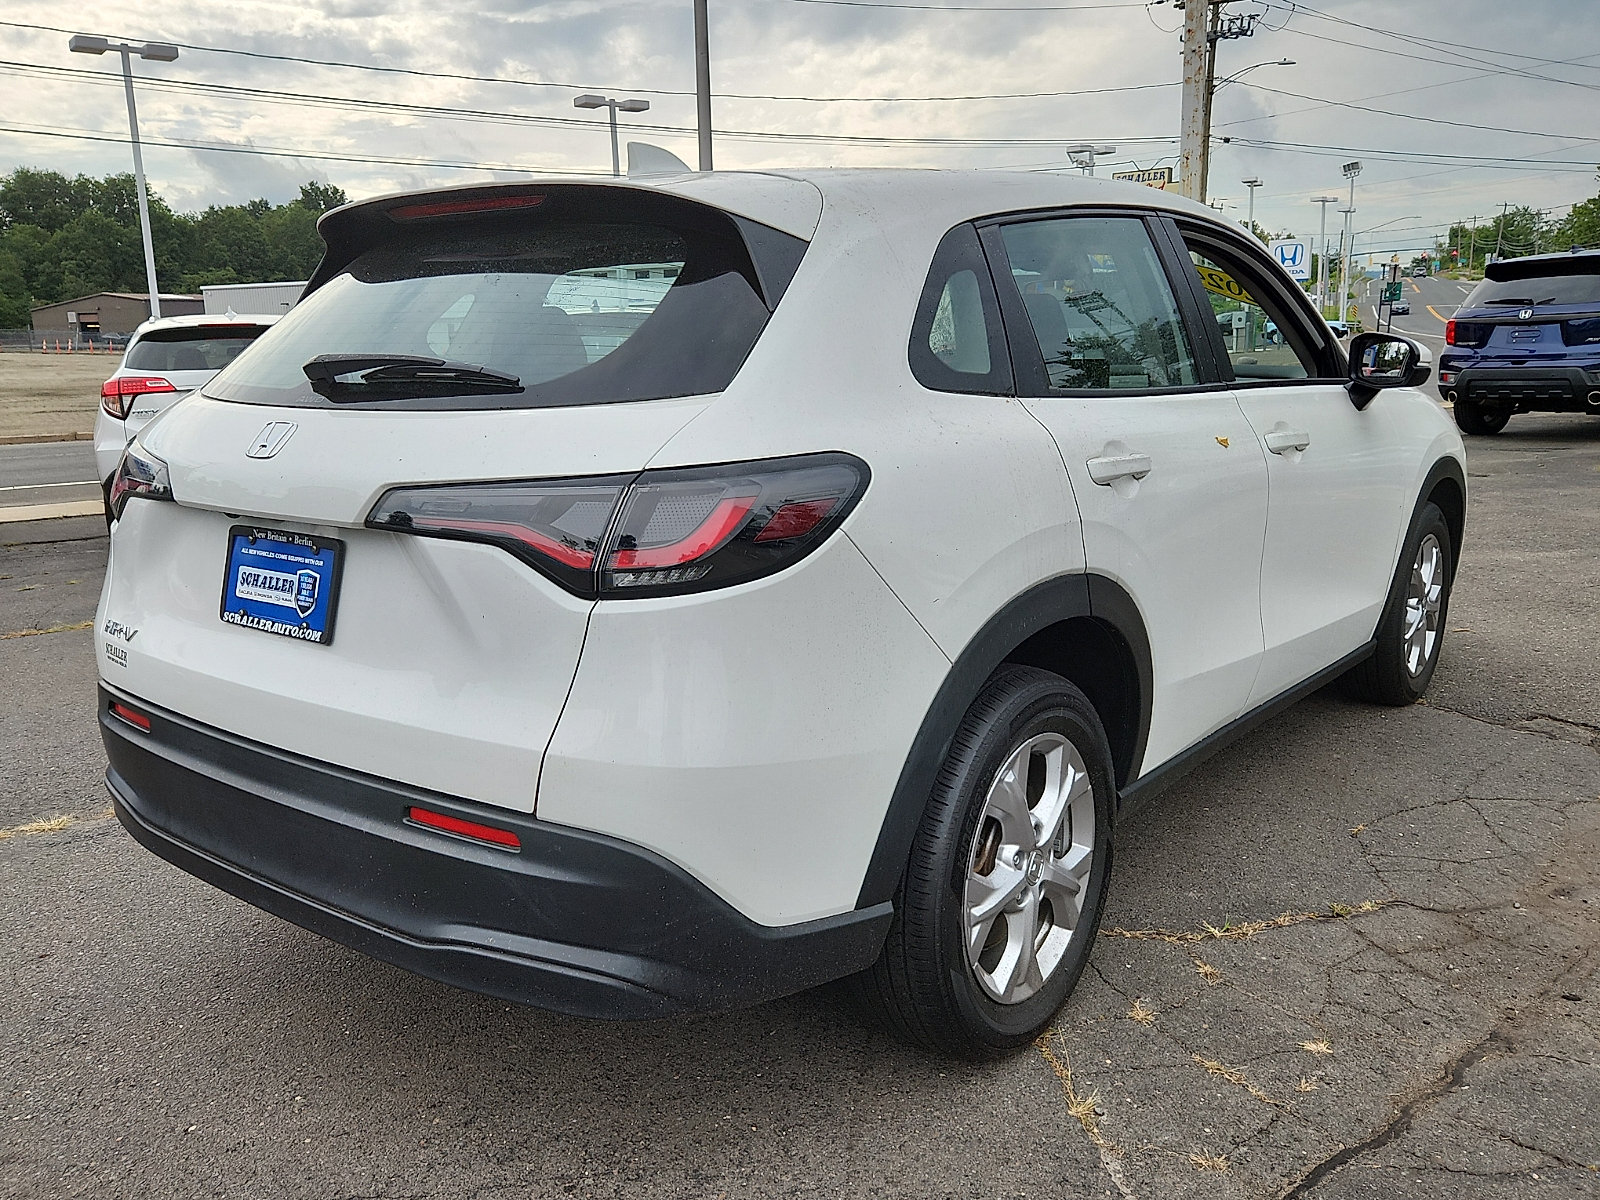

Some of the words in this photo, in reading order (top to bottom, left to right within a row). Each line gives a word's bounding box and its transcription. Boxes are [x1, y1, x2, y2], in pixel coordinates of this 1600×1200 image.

[252, 529, 266, 539] New
[267, 530, 288, 543] Britain
[294, 534, 313, 547] Berlin
[239, 571, 295, 598] SCHALLER
[222, 611, 323, 643] SCHALLERAUTO.COM
